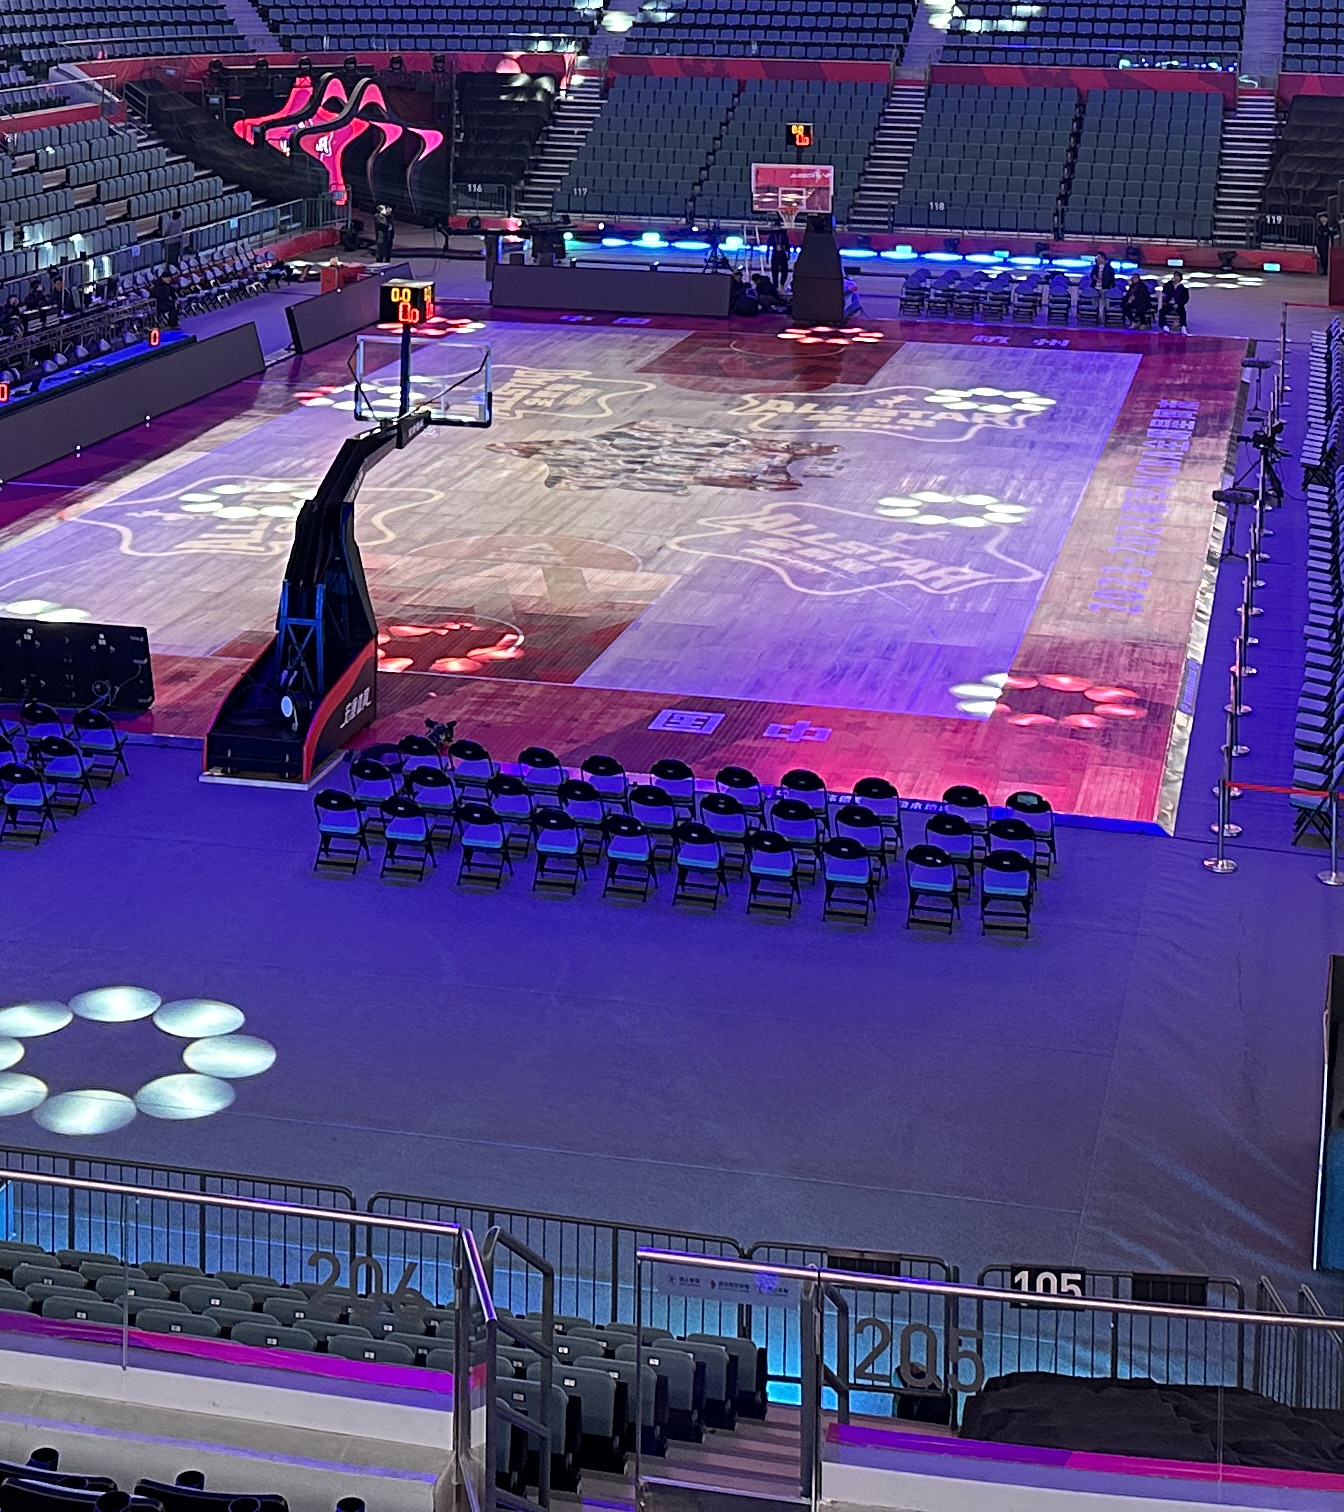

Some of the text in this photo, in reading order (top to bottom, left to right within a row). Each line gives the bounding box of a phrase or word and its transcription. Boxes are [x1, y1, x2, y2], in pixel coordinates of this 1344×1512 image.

[466, 183, 483, 194] 116
[572, 187, 588, 197] 117
[929, 201, 946, 212] 118
[1265, 214, 1283, 225] 119
[755, 398, 1015, 426] ALLSTAR
[731, 511, 997, 590] ALLSTAR
[1012, 1269, 1083, 1297] 105
[855, 1316, 986, 1395] 205
